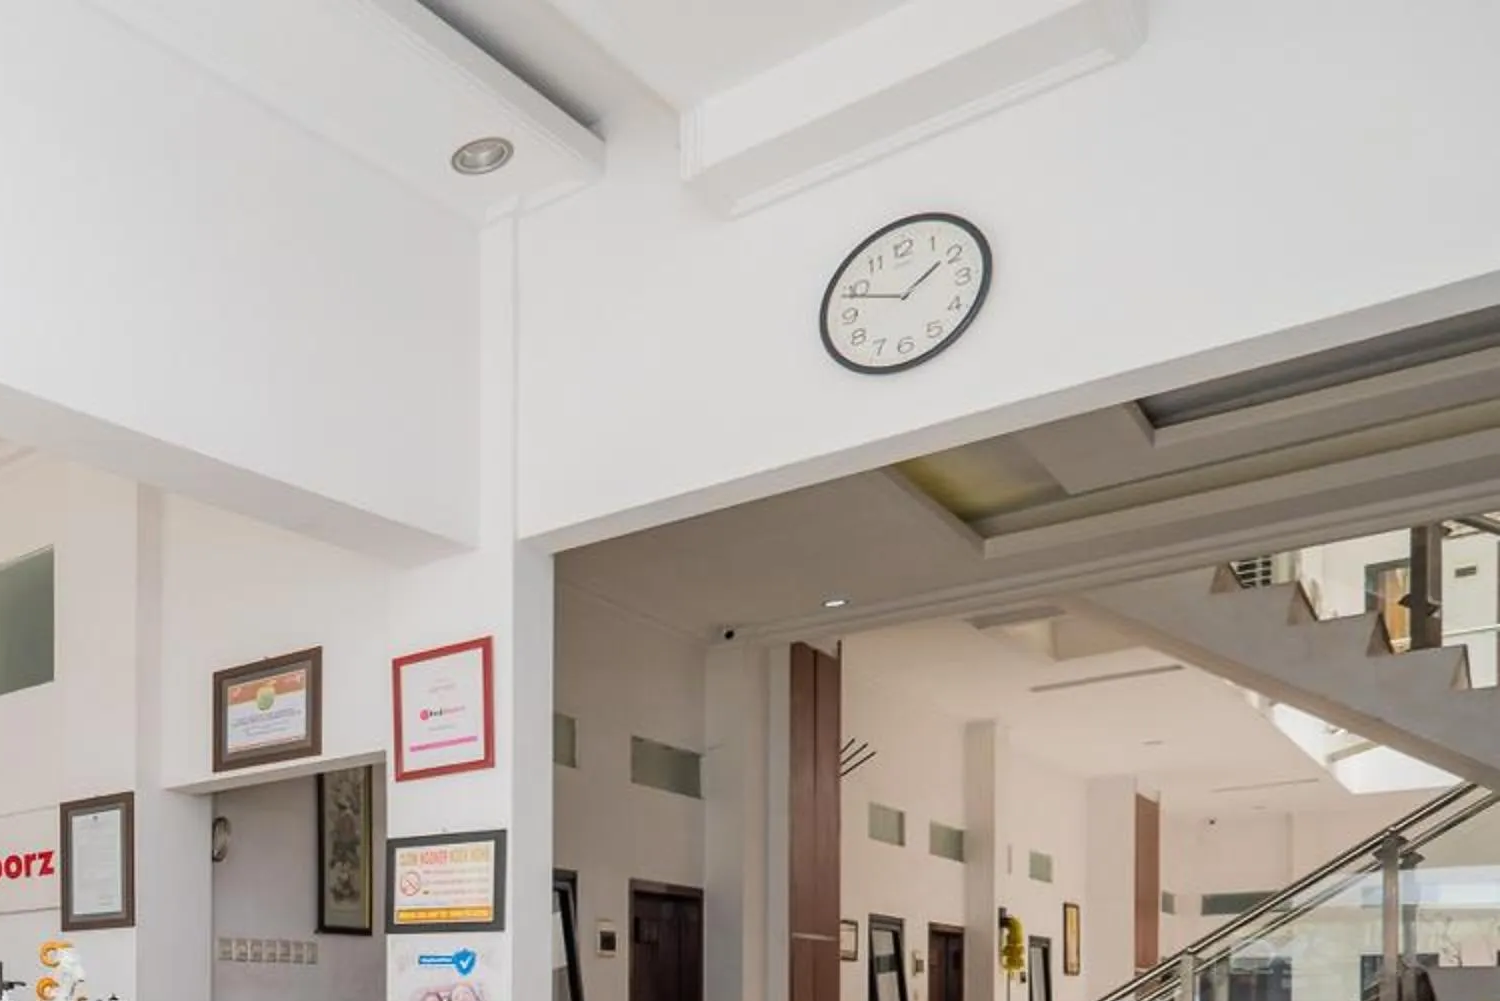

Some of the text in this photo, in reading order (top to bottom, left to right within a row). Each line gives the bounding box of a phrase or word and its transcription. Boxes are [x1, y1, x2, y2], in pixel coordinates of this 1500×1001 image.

[893, 238, 915, 259] 12
[946, 243, 963, 265] 2
[868, 255, 884, 274] 11
[955, 267, 972, 287] 3
[947, 295, 963, 313] 4
[841, 307, 859, 326] 9
[851, 327, 867, 347] 8
[927, 319, 944, 339] 5
[872, 337, 887, 356] 7
[897, 336, 916, 355] 6
